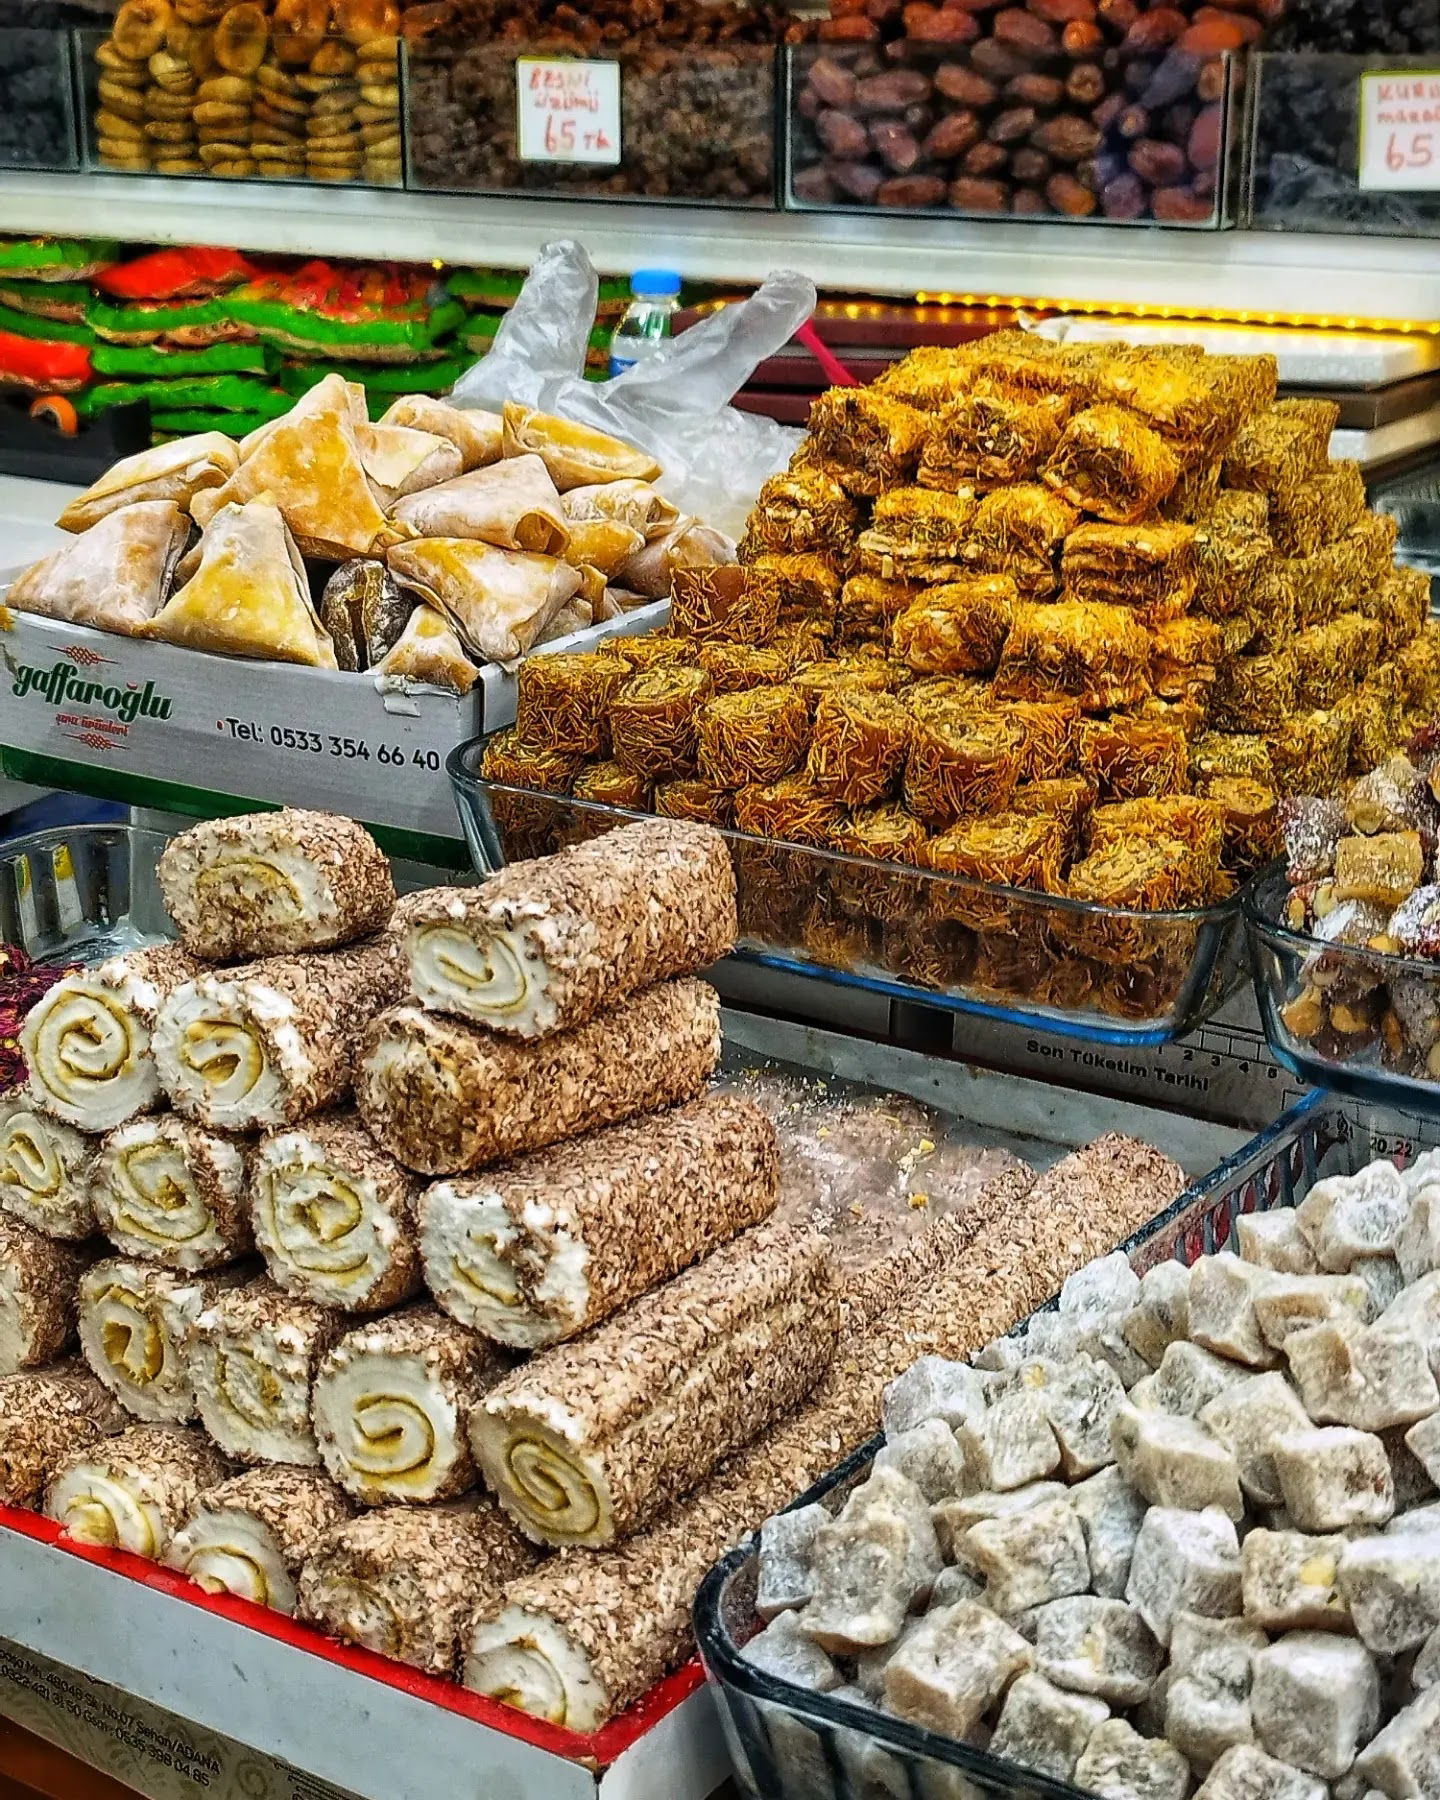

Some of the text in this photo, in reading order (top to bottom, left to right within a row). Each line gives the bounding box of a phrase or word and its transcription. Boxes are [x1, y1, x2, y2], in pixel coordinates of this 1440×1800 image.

[545, 113, 576, 153] 65
[1385, 132, 1433, 171] 65
[12, 662, 173, 722] gaffaroğlu
[226, 718, 440, 771] Tel: 0533 354 66 40
[1026, 1039, 1064, 1059] Son
[1238, 1061, 1250, 1074] 4
